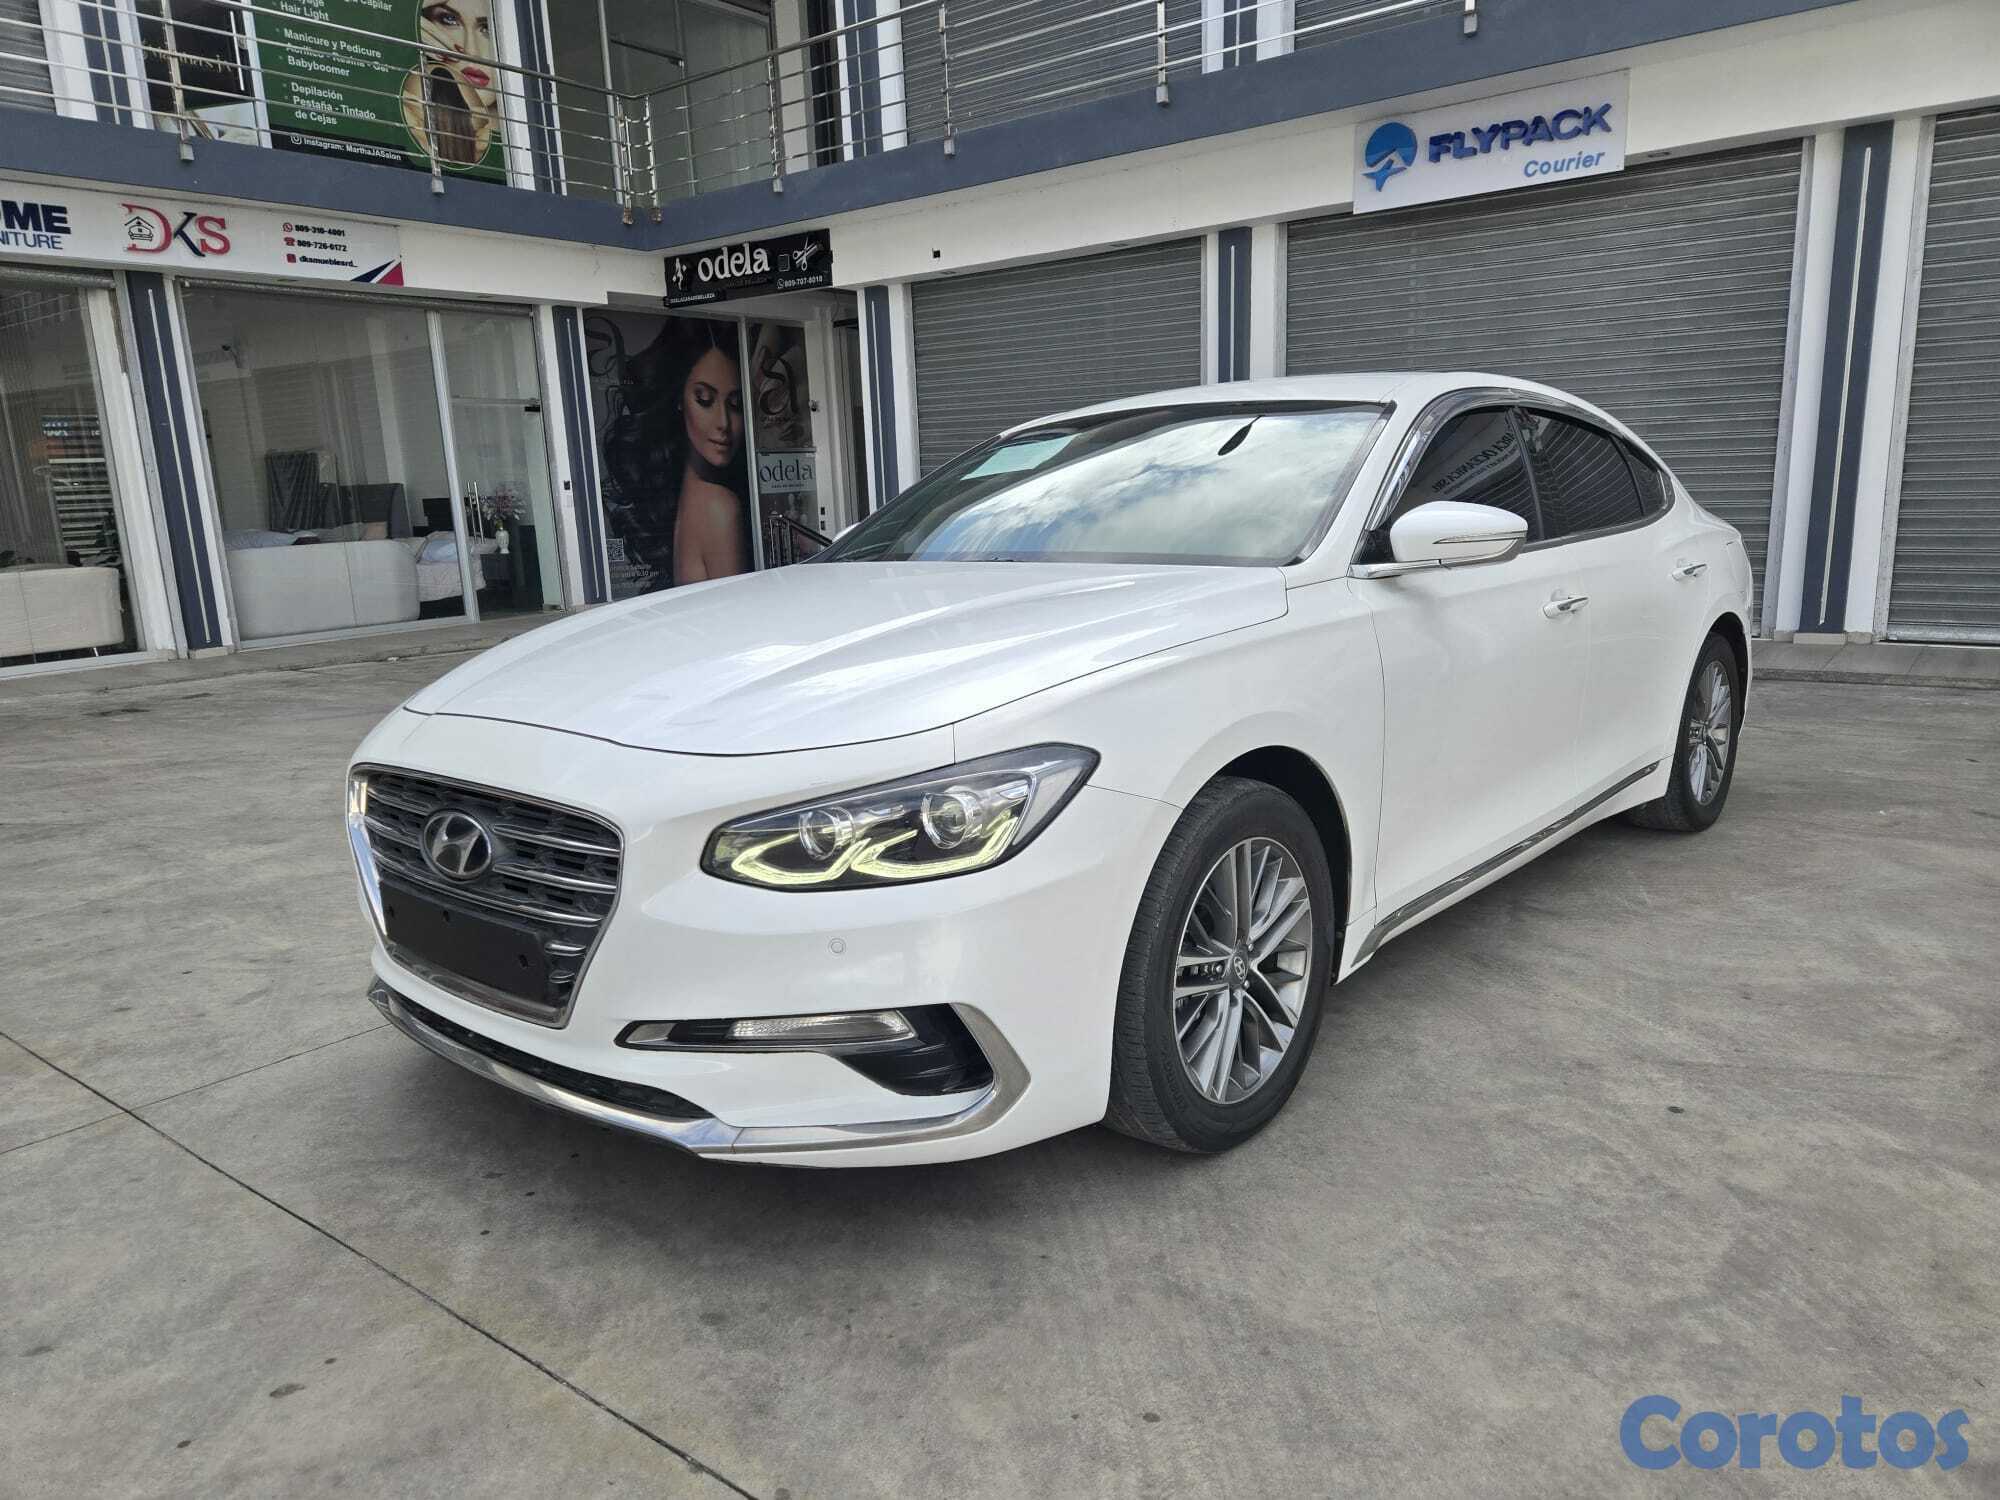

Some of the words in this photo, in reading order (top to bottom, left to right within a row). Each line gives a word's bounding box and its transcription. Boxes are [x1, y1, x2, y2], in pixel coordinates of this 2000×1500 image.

[281, 1, 301, 15] Hair
[303, 6, 329, 21] Light
[284, 28, 330, 47] Manicure
[340, 40, 382, 58] Pedicure
[287, 55, 350, 77] Babyboomer
[291, 82, 343, 101] Depilación
[293, 96, 333, 114] Pestaña
[341, 105, 376, 120] Tintado
[295, 110, 308, 119] de
[310, 111, 337, 125] Cejas
[1428, 103, 1612, 163] FLYPACK
[1524, 151, 1605, 178] Courier
[0, 200, 71, 234] ME
[121, 203, 231, 257] DKS
[697, 242, 771, 282] odela
[760, 459, 813, 482] odela
